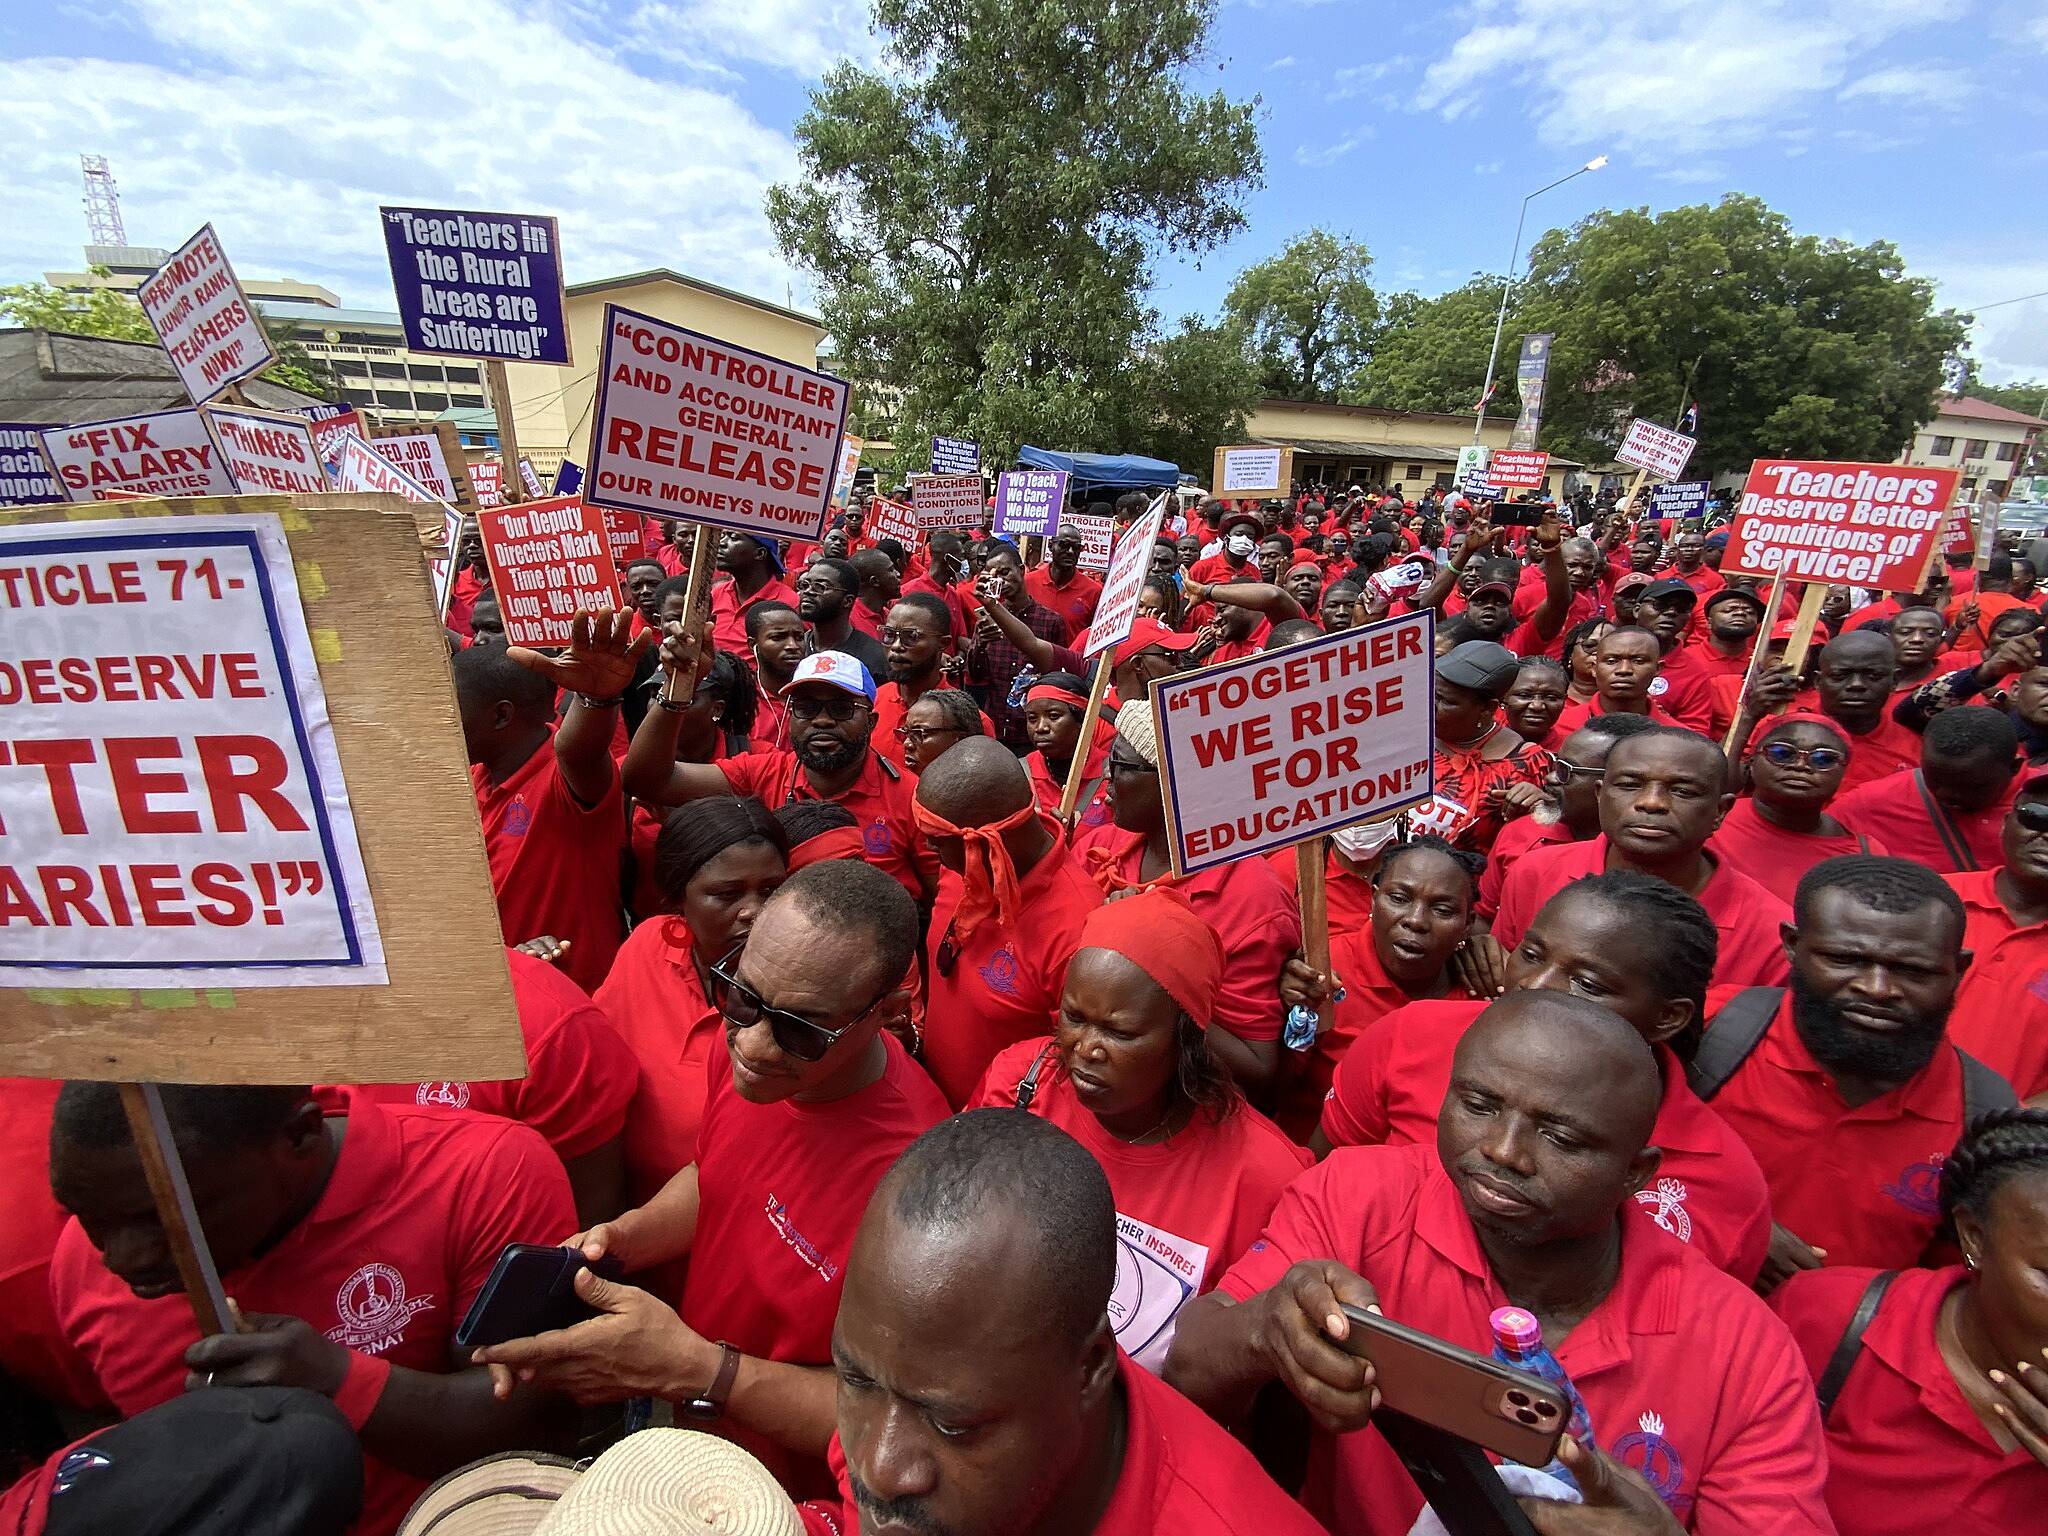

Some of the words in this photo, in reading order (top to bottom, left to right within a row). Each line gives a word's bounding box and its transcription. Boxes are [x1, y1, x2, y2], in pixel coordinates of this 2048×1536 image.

[389, 212, 518, 251] “Teachers
[521, 219, 548, 253] in
[416, 249, 460, 283] the
[461, 251, 531, 288] Rural
[159, 295, 195, 338] JUNIOR
[194, 269, 230, 306] RANK
[420, 283, 493, 320] Areas
[496, 294, 539, 323] are
[170, 300, 247, 368] TEACHERS
[419, 317, 548, 359] Suffering!”
[201, 338, 244, 386] NOW!”
[615, 321, 835, 411] “CONTROLLER
[613, 363, 671, 395] AND
[678, 382, 836, 440] ACCOUNTANT
[68, 423, 160, 457] “FIX
[219, 421, 305, 463] “THINGS
[678, 406, 794, 453] GENERAL
[1636, 422, 1677, 443] “INVEST
[1677, 440, 1689, 449] IN
[0, 452, 49, 473] ach
[61, 445, 212, 489] SALARY
[373, 443, 402, 462] EED
[406, 441, 431, 460] JOB
[419, 461, 435, 479] IN
[607, 416, 824, 498] RELEASE
[1492, 463, 1514, 472] Tough
[1515, 464, 1539, 474] Times
[1627, 440, 1667, 461] “INVEST
[1668, 456, 1680, 466] IN
[232, 459, 261, 485] ARE
[258, 465, 323, 492] REALLY
[478, 464, 498, 478] Our
[916, 479, 979, 489] “TEACHERS
[1006, 473, 1026, 487] “We
[1027, 473, 1058, 489] Teach,
[1501, 474, 1519, 482] Need
[1764, 466, 1938, 506] “Teachers
[598, 471, 652, 496] OUR
[660, 483, 753, 514] MONEYS
[760, 503, 819, 526] NOW!”
[877, 500, 904, 521] “Pay
[917, 498, 979, 508] CONDITIONS
[1006, 488, 1023, 502] We
[1023, 488, 1048, 503] Care
[1006, 503, 1023, 517] We
[1022, 503, 1050, 518] Need
[1652, 492, 1681, 502] Junior
[1681, 490, 1705, 500] Rank
[1656, 500, 1698, 511] Teachers
[1738, 493, 1847, 522] Deserve
[1850, 501, 1943, 531] Better
[497, 514, 529, 539] “Our
[528, 506, 584, 536] Deputy
[877, 514, 919, 541] Legacy
[918, 513, 982, 526] SERVICE!”
[1002, 517, 1050, 534] Support!”
[1740, 518, 1886, 553] Conditions
[1888, 534, 1923, 557] of
[494, 539, 561, 567] Directors
[560, 530, 602, 560] Mark
[1740, 541, 1903, 583] Service!”
[509, 567, 545, 591] Time
[545, 565, 567, 588] for
[567, 562, 598, 586] Too
[506, 594, 542, 619] Long
[547, 591, 574, 615] We
[573, 586, 616, 612] Need
[1106, 577, 1140, 615] DEMAND
[508, 620, 524, 642] to
[523, 619, 543, 641] be
[0, 653, 266, 705] DESERVE
[1169, 625, 1423, 717] “TOGETHER
[1190, 715, 1273, 769] WE
[1291, 676, 1404, 742] RISE
[0, 734, 310, 835] TER
[1252, 736, 1361, 800] FOR
[1184, 759, 1429, 859] EDUCATION!”
[1145, 1234, 1196, 1276] INSPIRES
